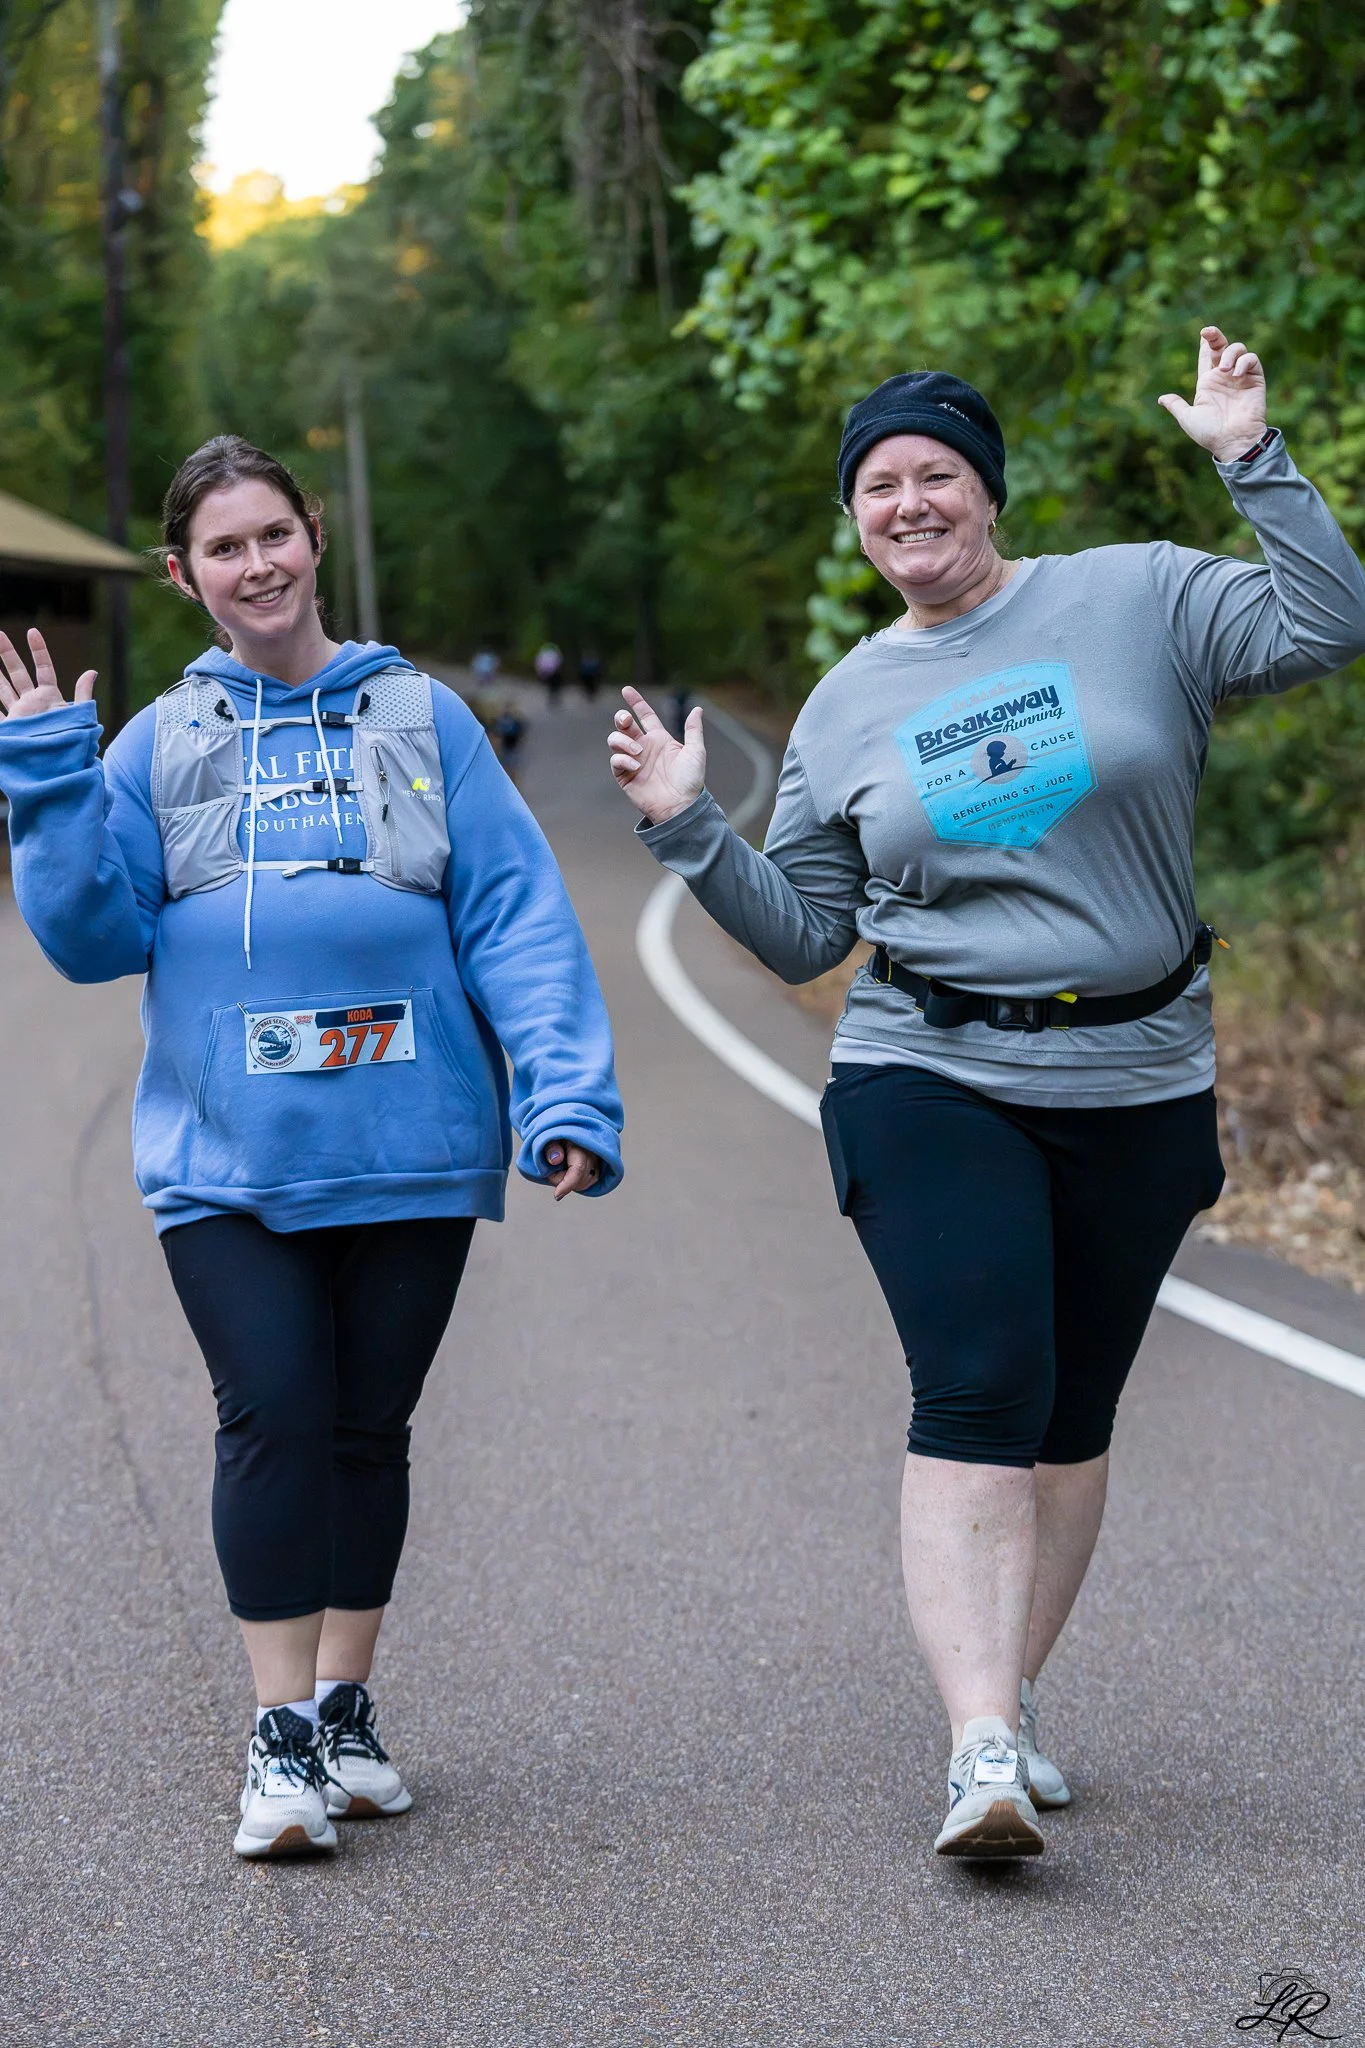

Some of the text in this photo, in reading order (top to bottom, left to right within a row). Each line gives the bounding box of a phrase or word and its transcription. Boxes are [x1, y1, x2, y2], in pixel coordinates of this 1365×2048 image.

[915, 685, 1060, 754] Breakaway
[1002, 706, 1065, 734] Running
[243, 755, 288, 780] AL
[926, 731, 1076, 790] FOR A CAUSE
[952, 773, 1074, 821] BENEFITING ST. JUDE
[347, 1008, 374, 1023] KODA
[319, 1022, 399, 1068] 277
